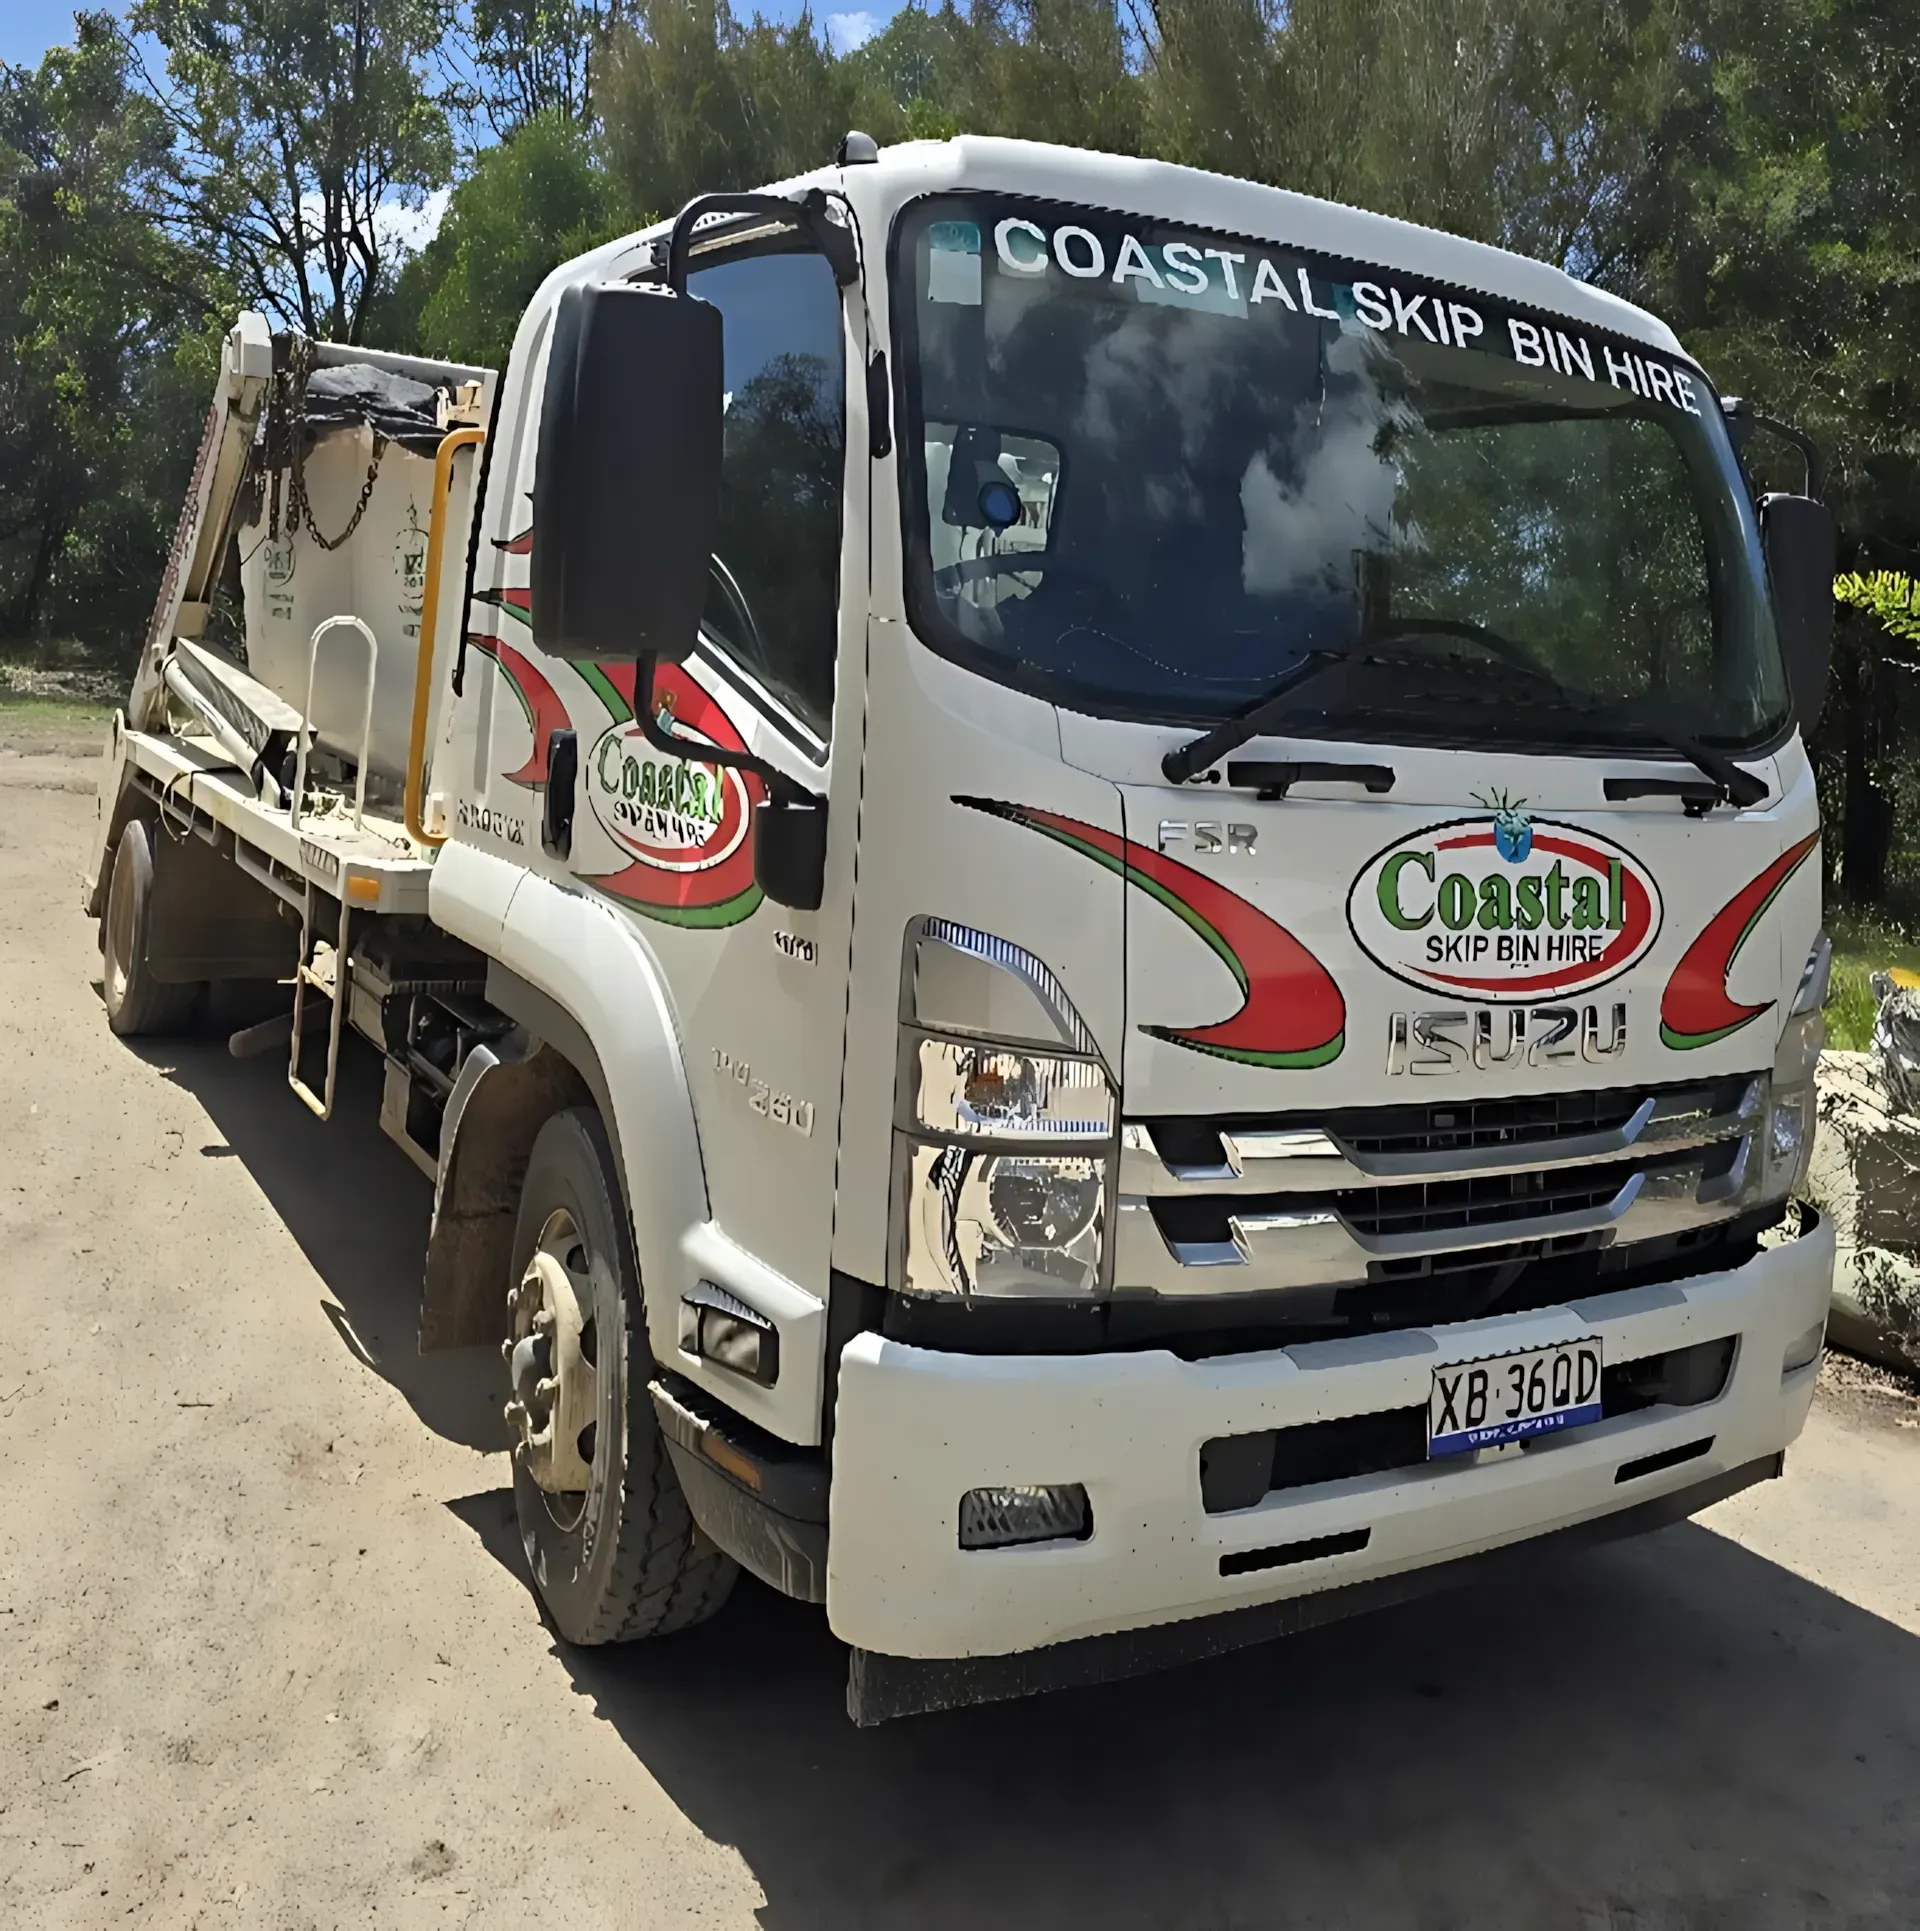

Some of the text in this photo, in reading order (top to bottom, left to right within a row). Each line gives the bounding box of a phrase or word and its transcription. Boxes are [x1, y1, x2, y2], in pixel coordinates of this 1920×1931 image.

[994, 217, 1702, 417] COASTAL SKIP BIN HIRE
[1158, 820, 1259, 856] FSR
[1376, 850, 1626, 931] Coastal
[1426, 934, 1605, 962] SKIP BIN HIRE
[1385, 1003, 1627, 1076] ISUZU
